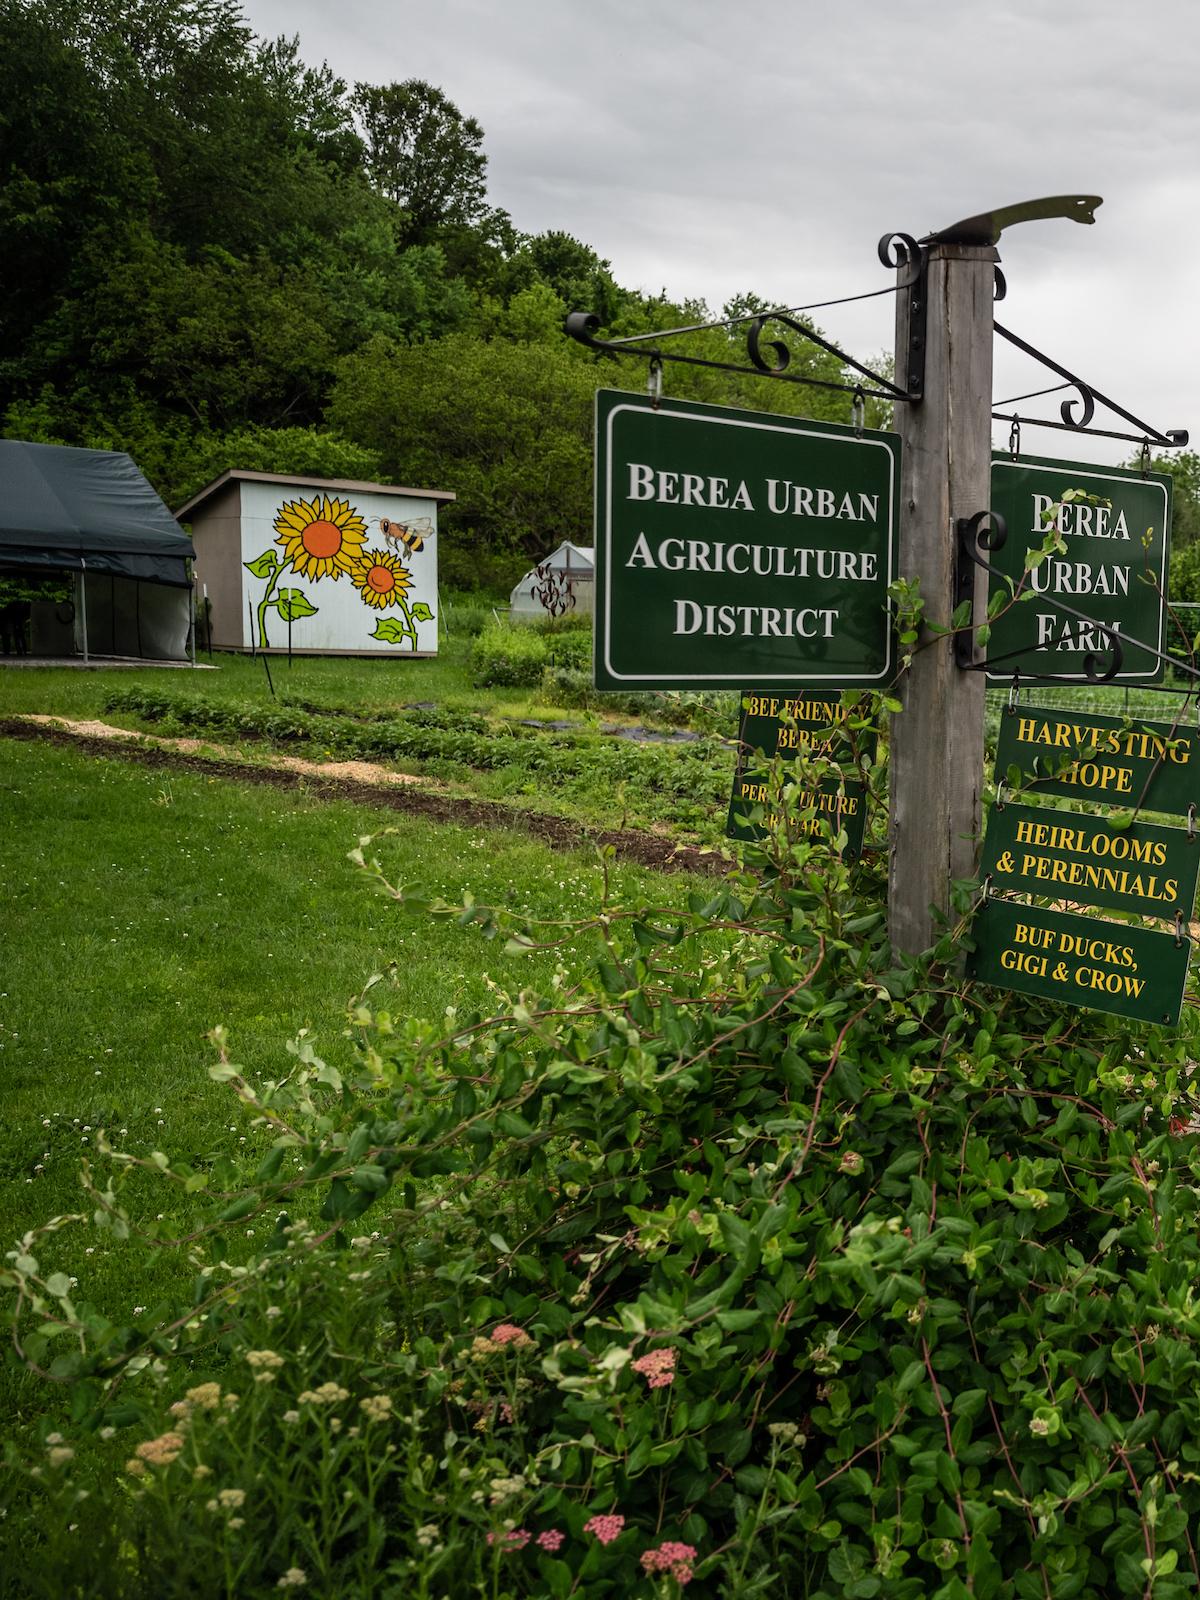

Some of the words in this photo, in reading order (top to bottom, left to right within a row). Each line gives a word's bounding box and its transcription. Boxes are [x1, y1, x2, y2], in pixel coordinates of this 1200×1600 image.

[626, 463, 755, 511] BEREA
[765, 479, 879, 522] URBAN
[625, 532, 878, 581] AGRICULTURE
[1028, 554, 1131, 597] URBAN
[672, 599, 839, 638] DISTRICT
[1016, 718, 1191, 764] HARVESTING
[1015, 820, 1167, 866] HEIRLOOMS
[996, 851, 1016, 873] &
[1021, 854, 1178, 902] PERENNIALS
[1014, 923, 1057, 949] BUF
[1058, 933, 1139, 972] DUCKS,
[1000, 949, 1049, 978] GIGI
[1051, 961, 1070, 983] &
[1074, 966, 1146, 999] CROW
